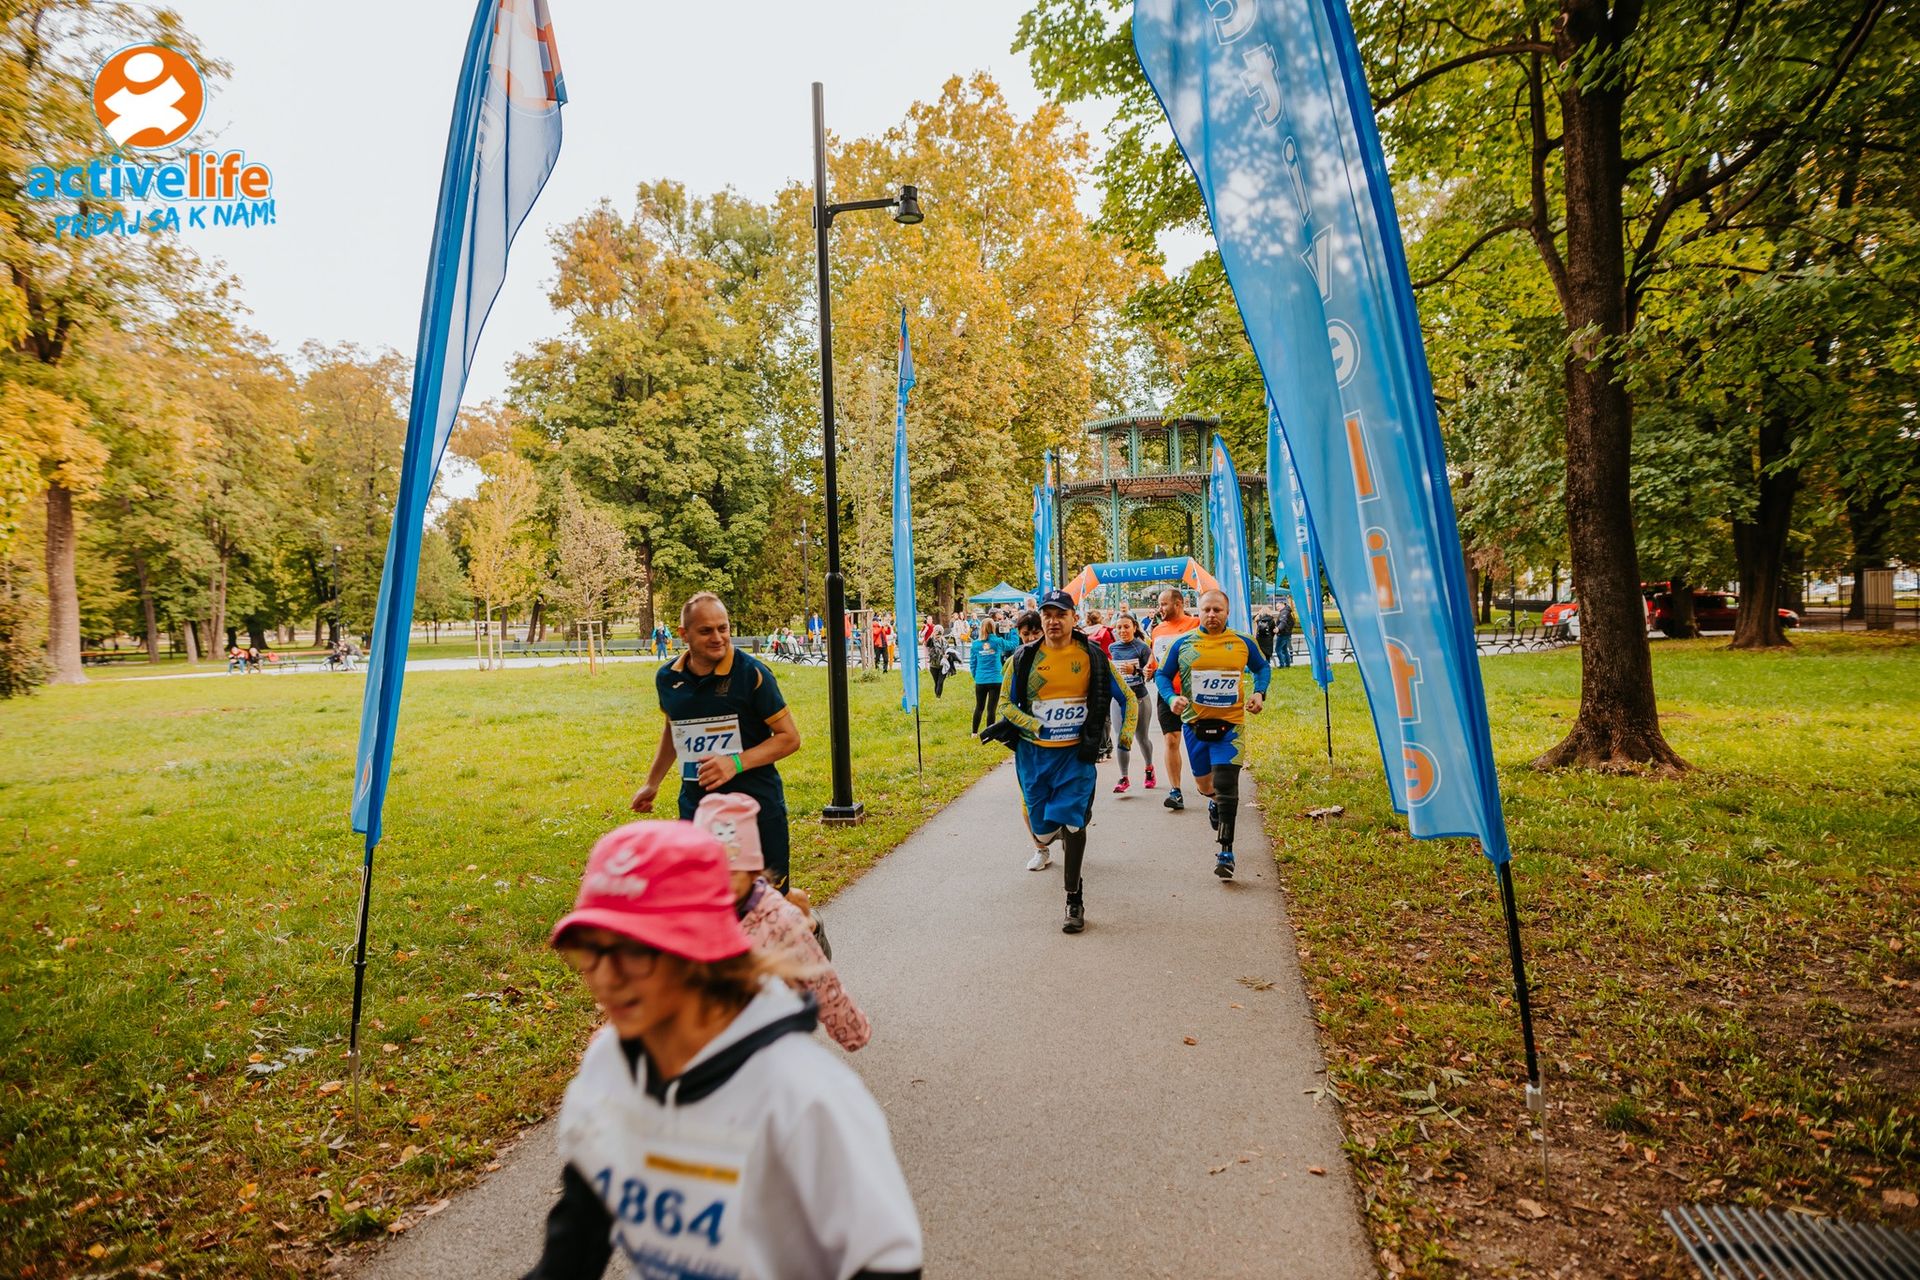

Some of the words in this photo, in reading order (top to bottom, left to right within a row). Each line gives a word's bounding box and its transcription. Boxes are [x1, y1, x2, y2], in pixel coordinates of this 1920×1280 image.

[1101, 567, 1148, 579] ACTIVE
[1153, 565, 1179, 577] LIFE
[1202, 678, 1236, 690] 1878
[1045, 706, 1085, 721] 1862
[684, 732, 734, 753] 1877
[594, 1166, 726, 1247] 1864
